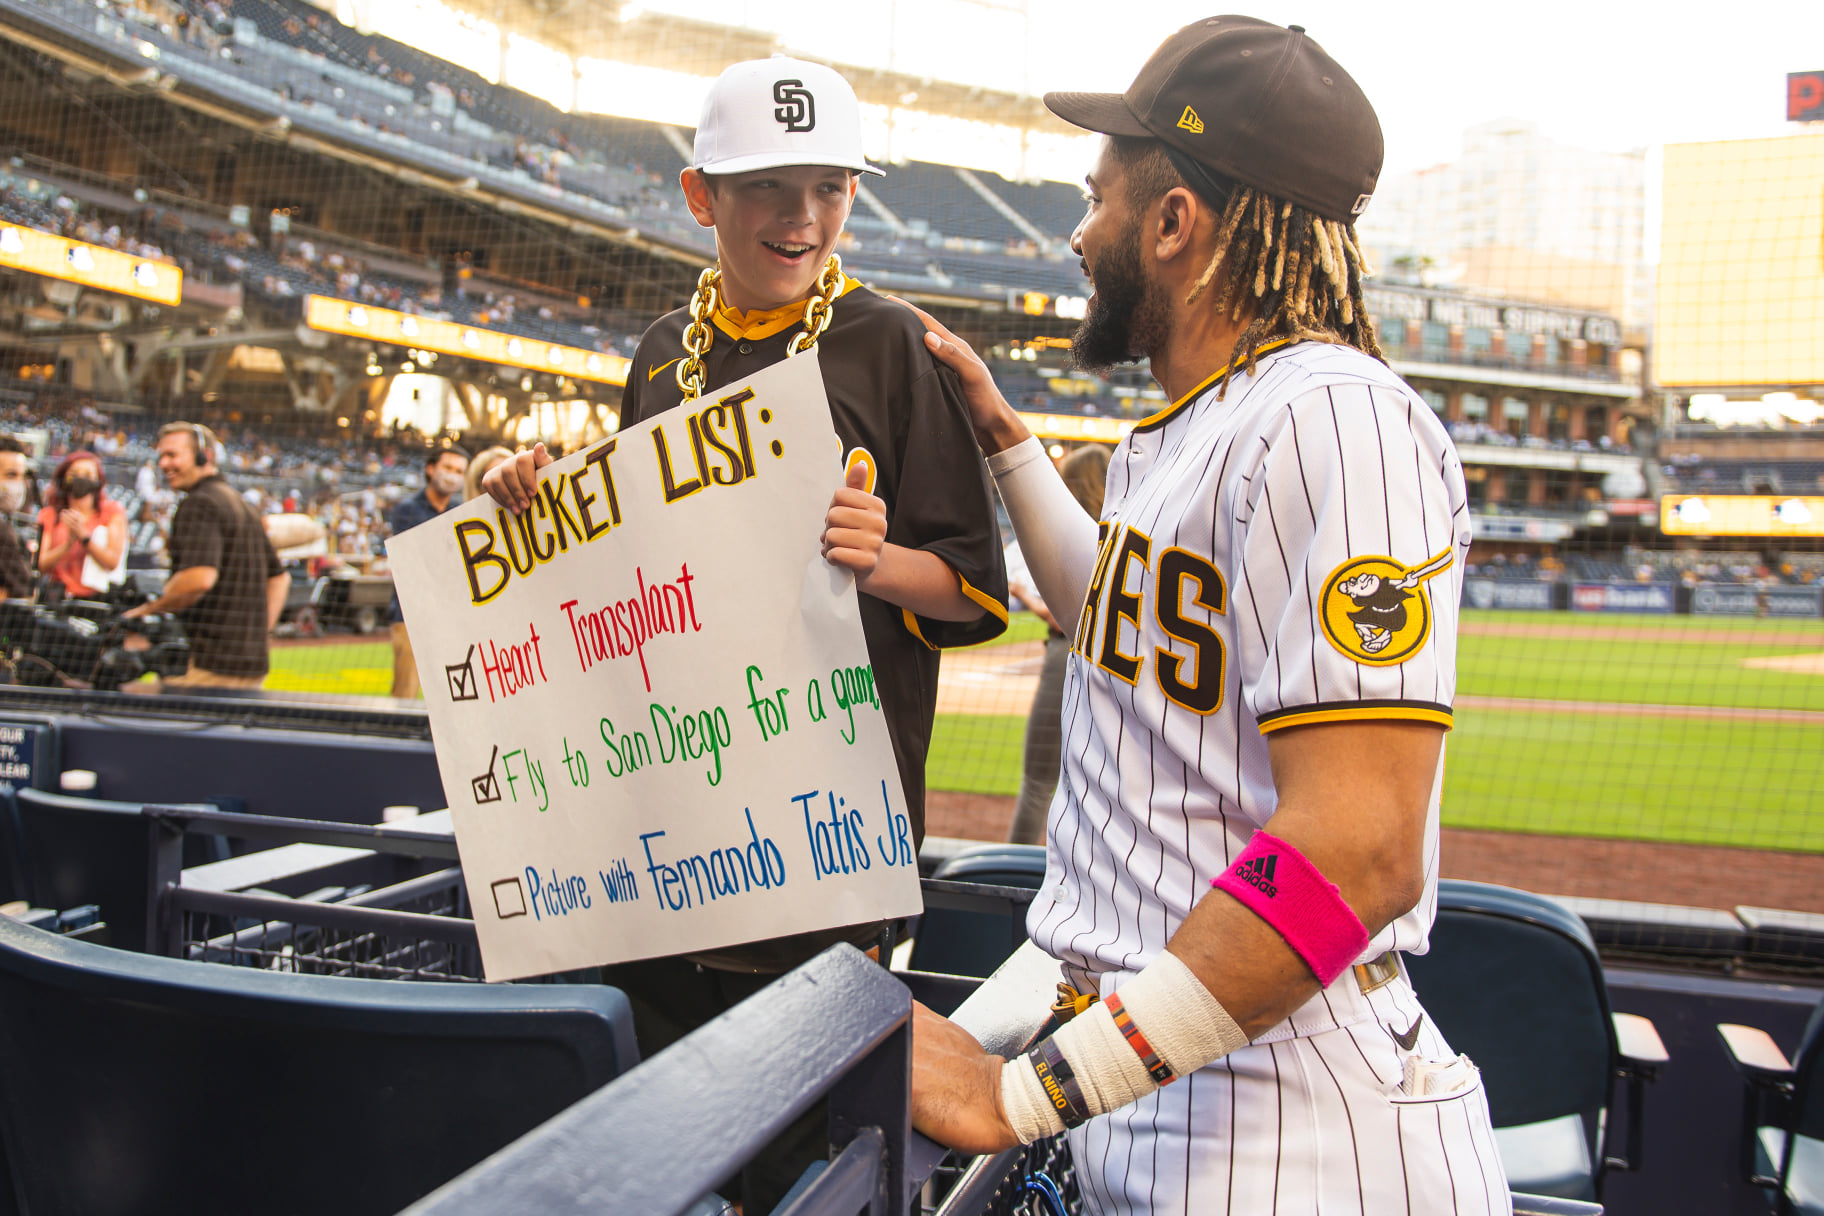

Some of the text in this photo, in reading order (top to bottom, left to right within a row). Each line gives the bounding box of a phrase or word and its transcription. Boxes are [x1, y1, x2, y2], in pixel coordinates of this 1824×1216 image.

[773, 79, 816, 133] SD
[454, 386, 785, 607] BUCKET LIST:
[478, 562, 702, 703] Heart Transplant
[0, 727, 25, 743] OUR
[503, 749, 549, 812] Fly
[562, 737, 590, 788] to
[746, 665, 790, 742] for
[808, 679, 827, 722] a
[831, 664, 880, 745] game
[526, 866, 592, 921] Picture
[599, 859, 640, 903] with
[640, 808, 786, 911] Fernando
[792, 790, 871, 881] Tatis
[1236, 865, 1278, 898] adidas
[1035, 1062, 1048, 1077] EL
